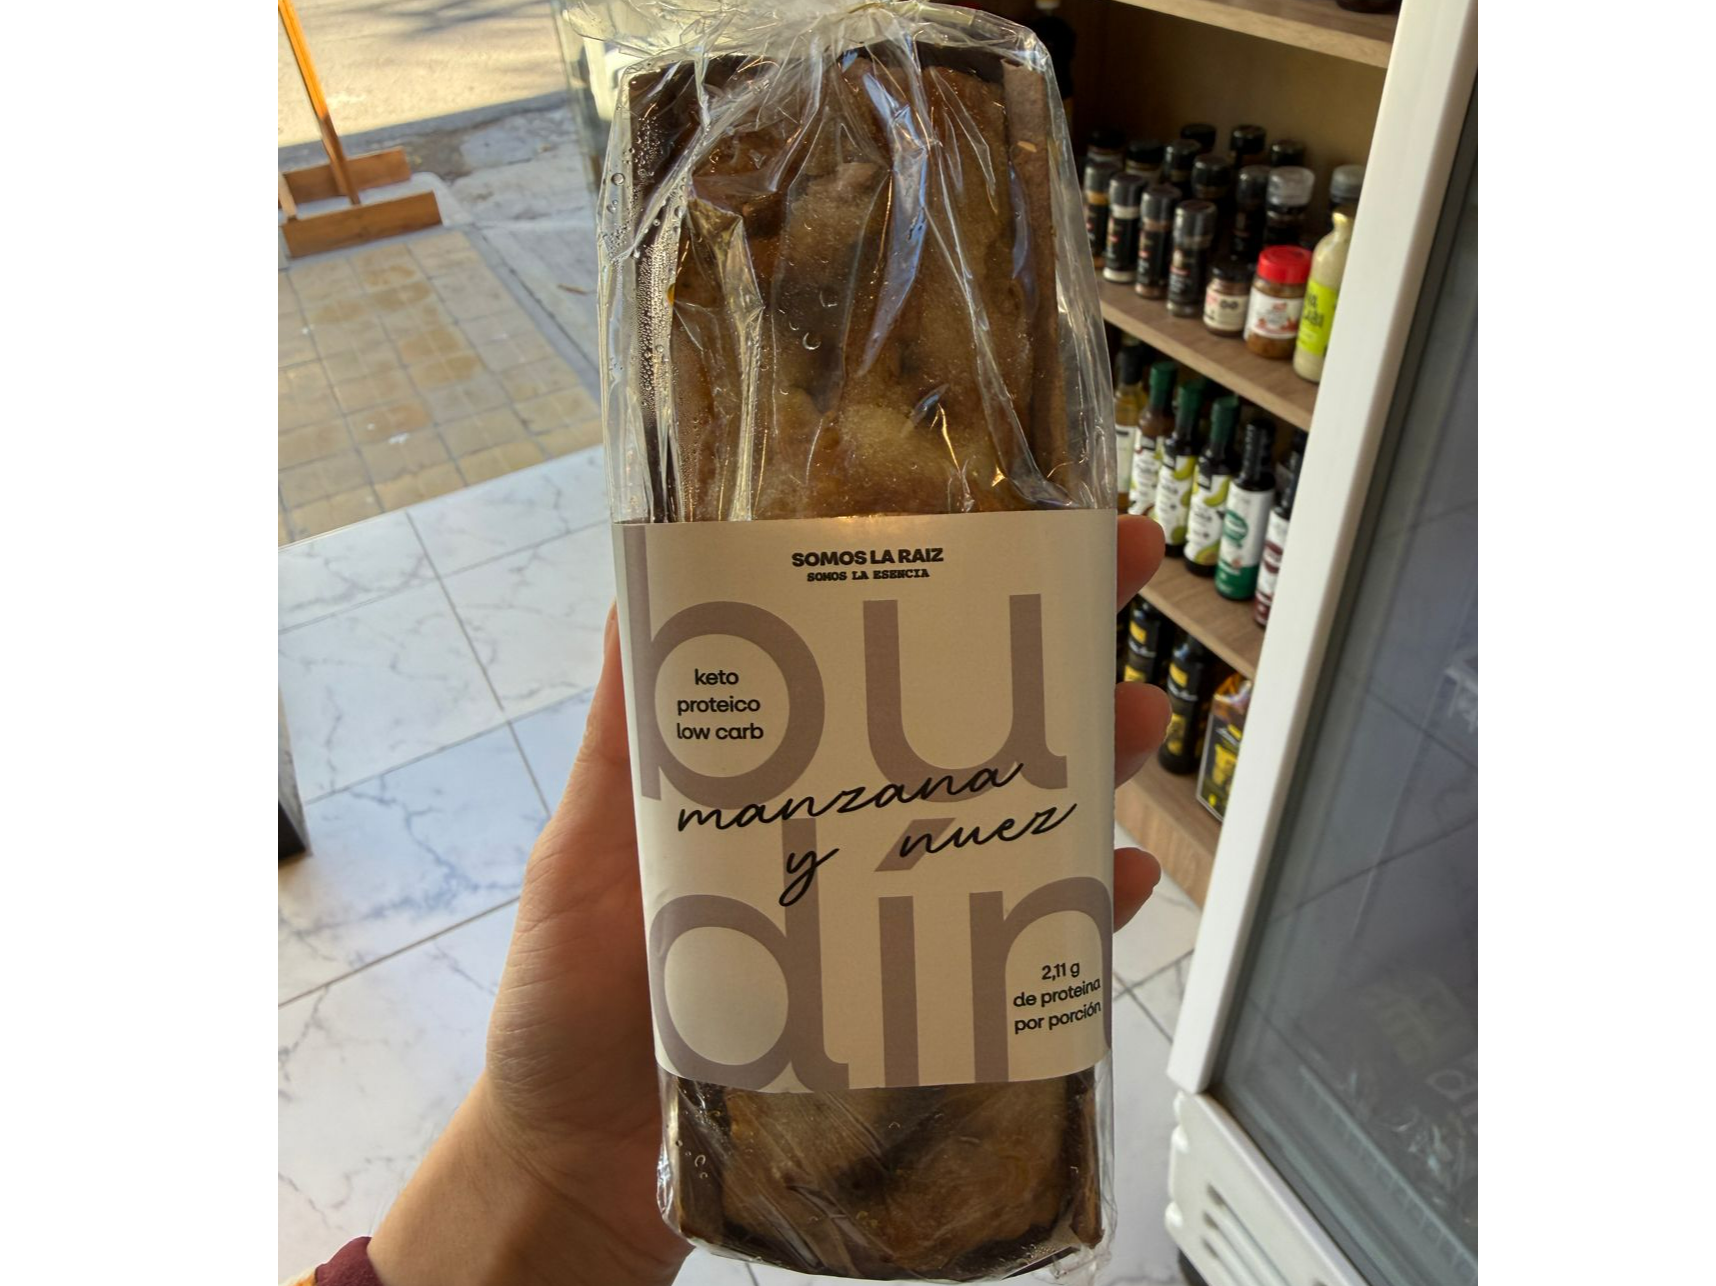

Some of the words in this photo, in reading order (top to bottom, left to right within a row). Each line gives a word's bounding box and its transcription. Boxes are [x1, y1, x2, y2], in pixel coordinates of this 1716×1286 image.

[791, 550, 868, 567] SOMOS
[870, 549, 896, 565] LA
[898, 547, 945, 564] RAIZ
[807, 571, 848, 582] SOMOS
[851, 570, 870, 581] LA
[873, 568, 930, 580] ESENCIA
[623, 525, 1068, 810] bu
[694, 668, 740, 686] keto
[677, 695, 762, 717] proteico
[676, 722, 711, 740] low
[715, 722, 764, 740] carb
[677, 762, 1025, 832] manzana
[778, 847, 840, 908] y
[899, 802, 1078, 859] nuez
[1041, 962, 1067, 981] 2,11
[1070, 962, 1081, 978] g
[1013, 991, 1037, 1007] de
[1014, 1017, 1045, 1035] por
[1048, 1001, 1102, 1031] porción
